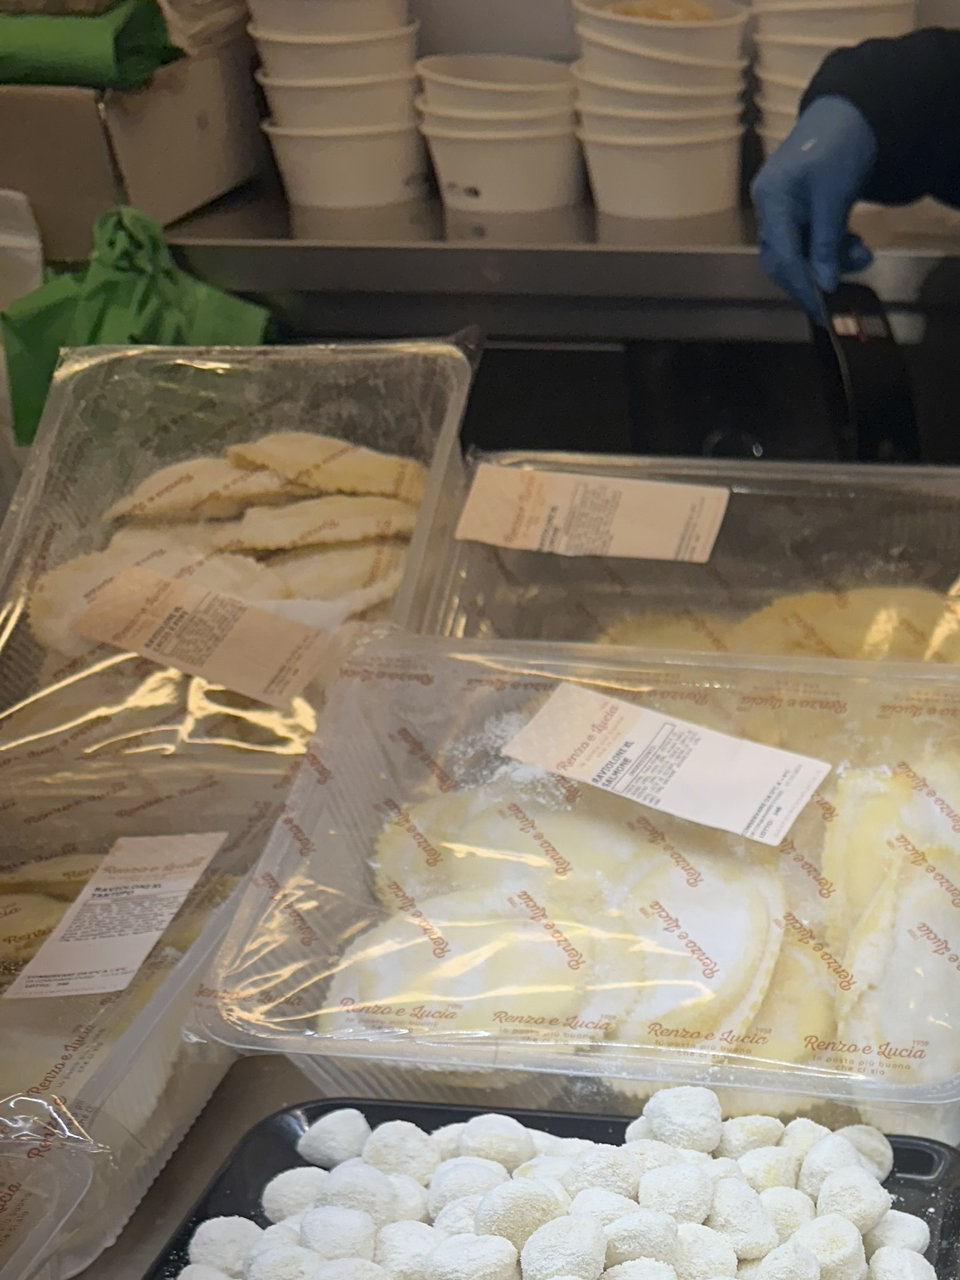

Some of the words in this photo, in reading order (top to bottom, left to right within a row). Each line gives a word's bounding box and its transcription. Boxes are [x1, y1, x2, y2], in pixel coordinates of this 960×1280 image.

[556, 741, 590, 772] Renzo
[592, 747, 625, 785] RAVIOLONI
[602, 757, 632, 788] SALMONE
[540, 840, 573, 876] Renzo
[895, 834, 928, 867] Lucia
[670, 851, 704, 888] Renzo
[800, 862, 836, 899] Renzo
[925, 865, 936, 874] e
[517, 890, 547, 921] Lucia
[649, 901, 681, 933] Lucia
[544, 921, 554, 930] e
[677, 931, 688, 940] e
[783, 912, 816, 945] Lucia
[916, 922, 952, 956] Lucia
[551, 929, 586, 970] Renzo
[685, 939, 720, 979] Renzo
[812, 942, 823, 952] e
[948, 953, 959, 963] e
[821, 950, 858, 991] Renzo
[411, 1004, 458, 1020] Lucia
[492, 1010, 545, 1026] Renzo
[548, 1017, 560, 1026] e
[565, 1014, 611, 1031] Lucia
[648, 1022, 700, 1039] Renzo
[704, 1032, 716, 1040] e
[719, 1029, 769, 1045] Lucia
[804, 1035, 860, 1053] Renzo
[861, 1045, 873, 1055] e
[877, 1042, 927, 1060] Lucia
[27, 1061, 67, 1095] Renzo
